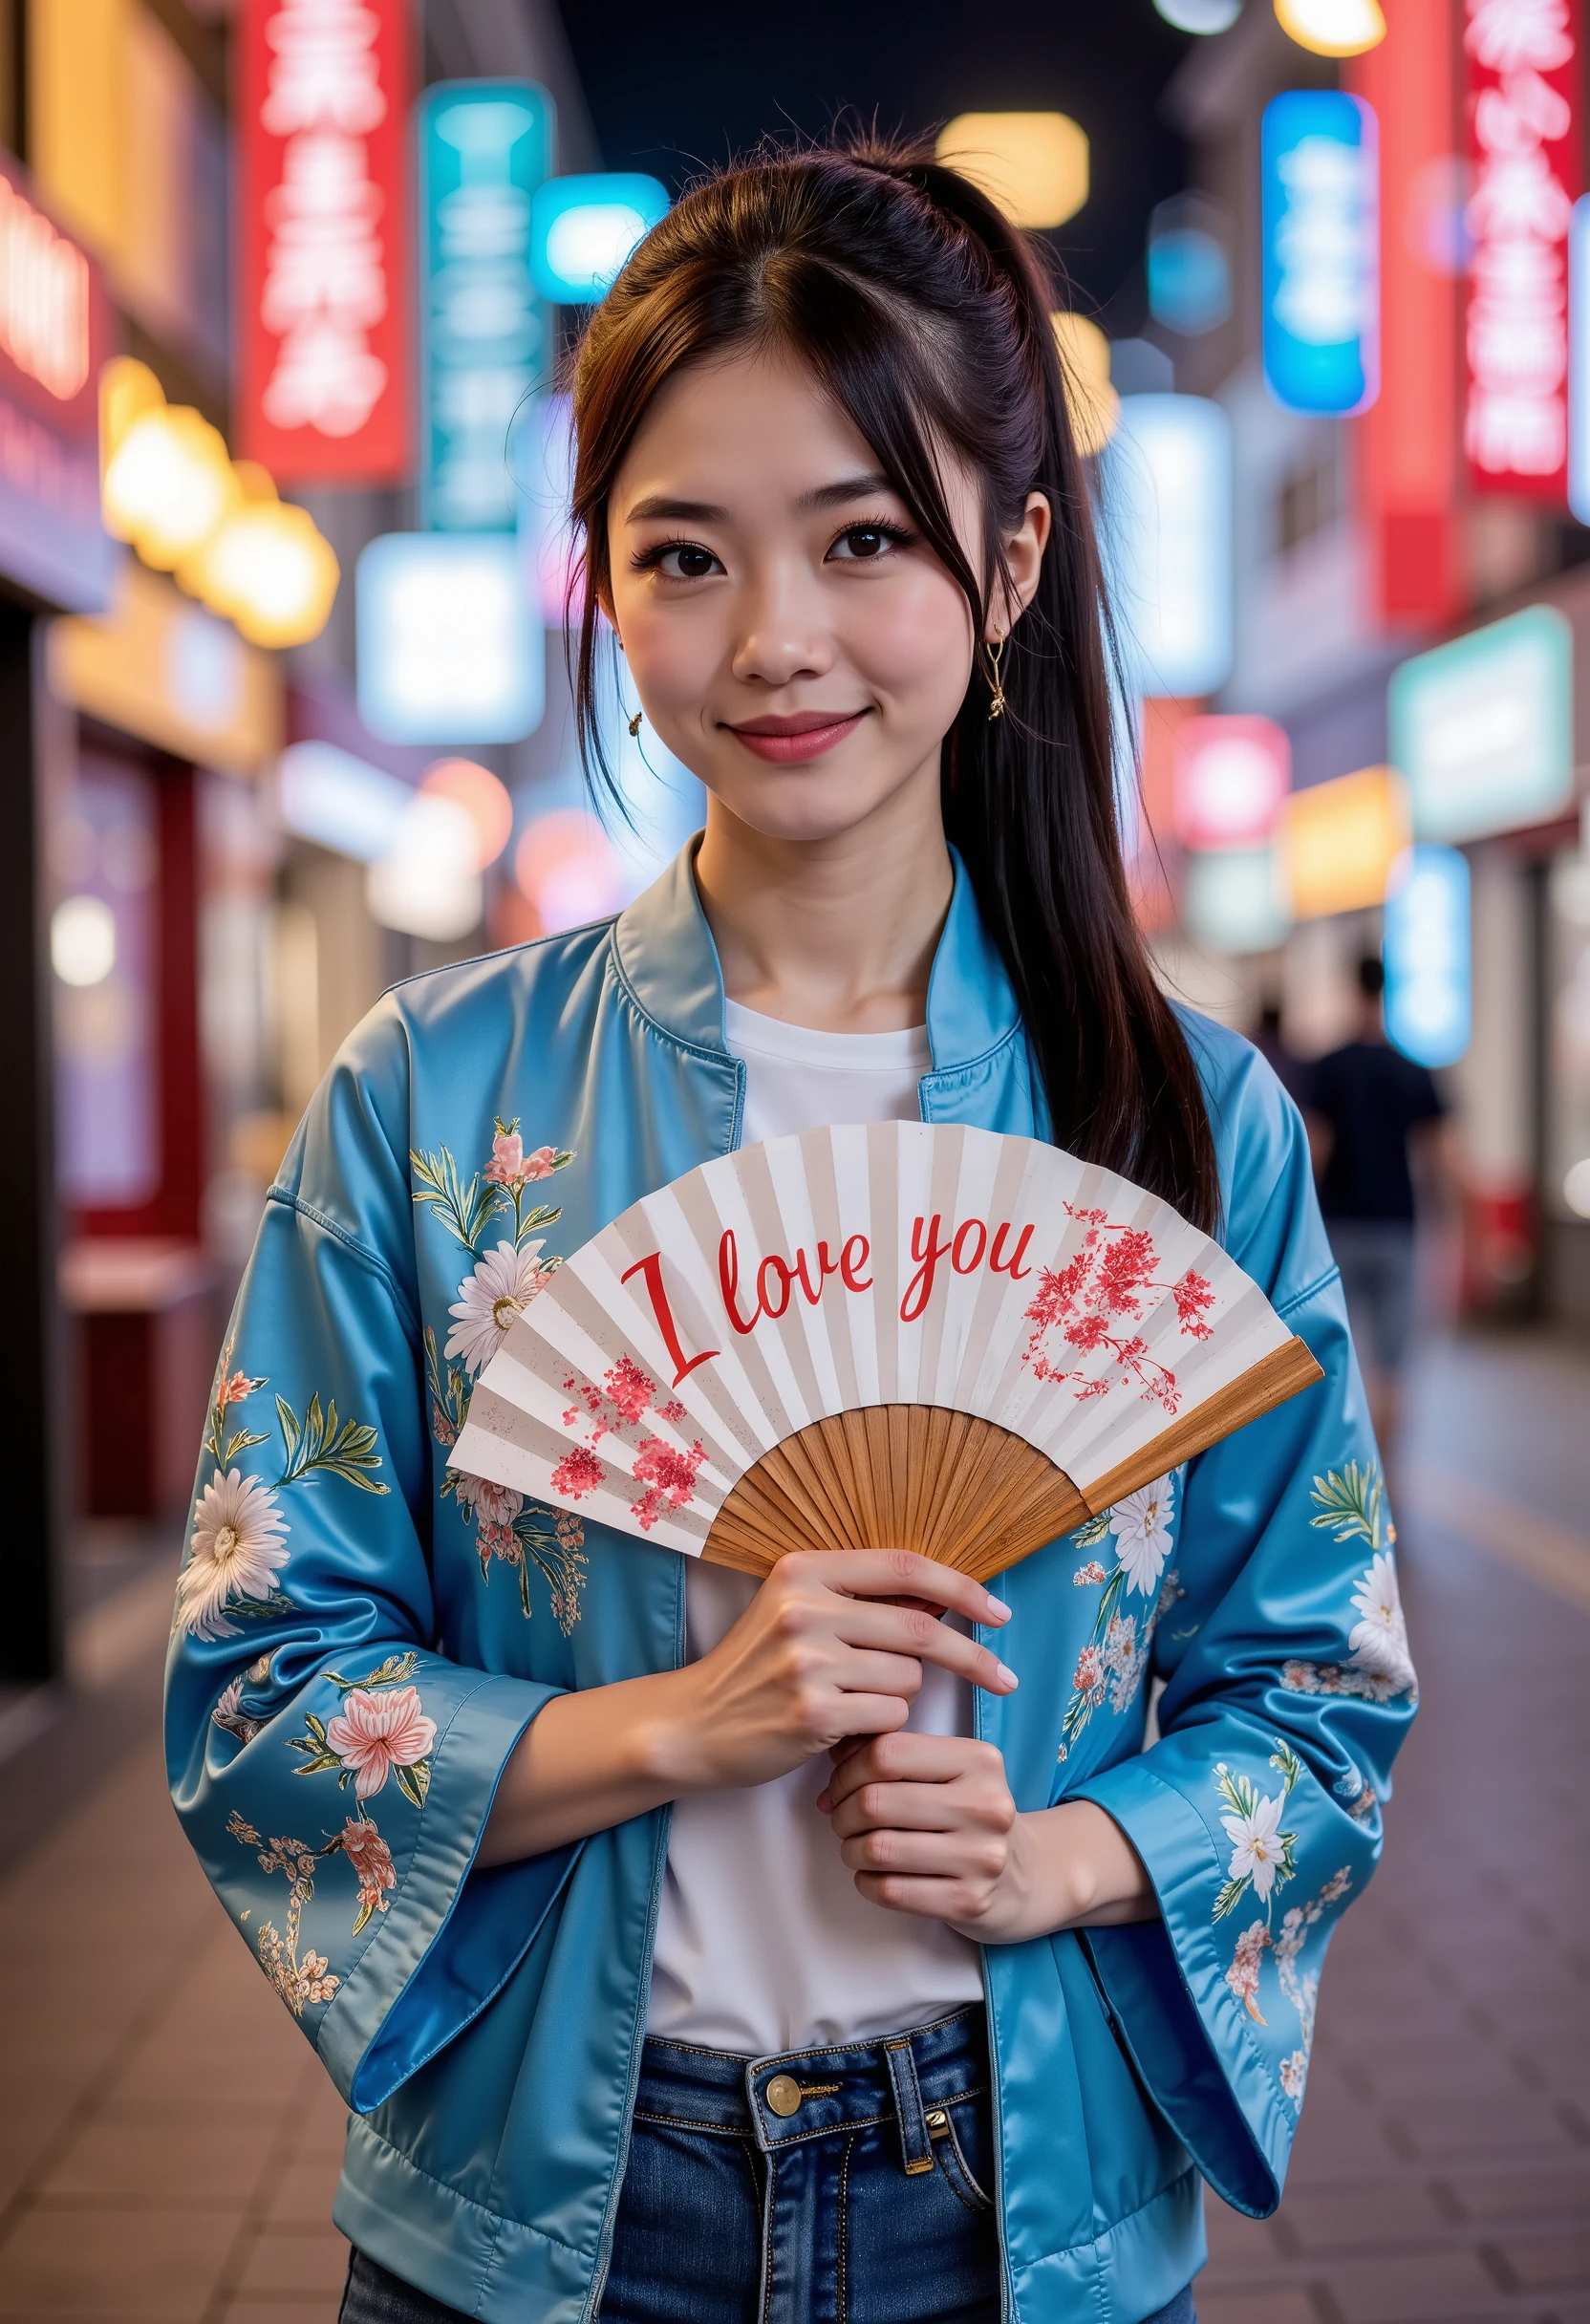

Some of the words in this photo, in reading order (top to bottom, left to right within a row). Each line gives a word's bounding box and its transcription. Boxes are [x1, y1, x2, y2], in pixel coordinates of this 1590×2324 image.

[620, 1251, 721, 1389] I
[719, 1229, 873, 1335] love
[899, 1214, 1036, 1323] you
